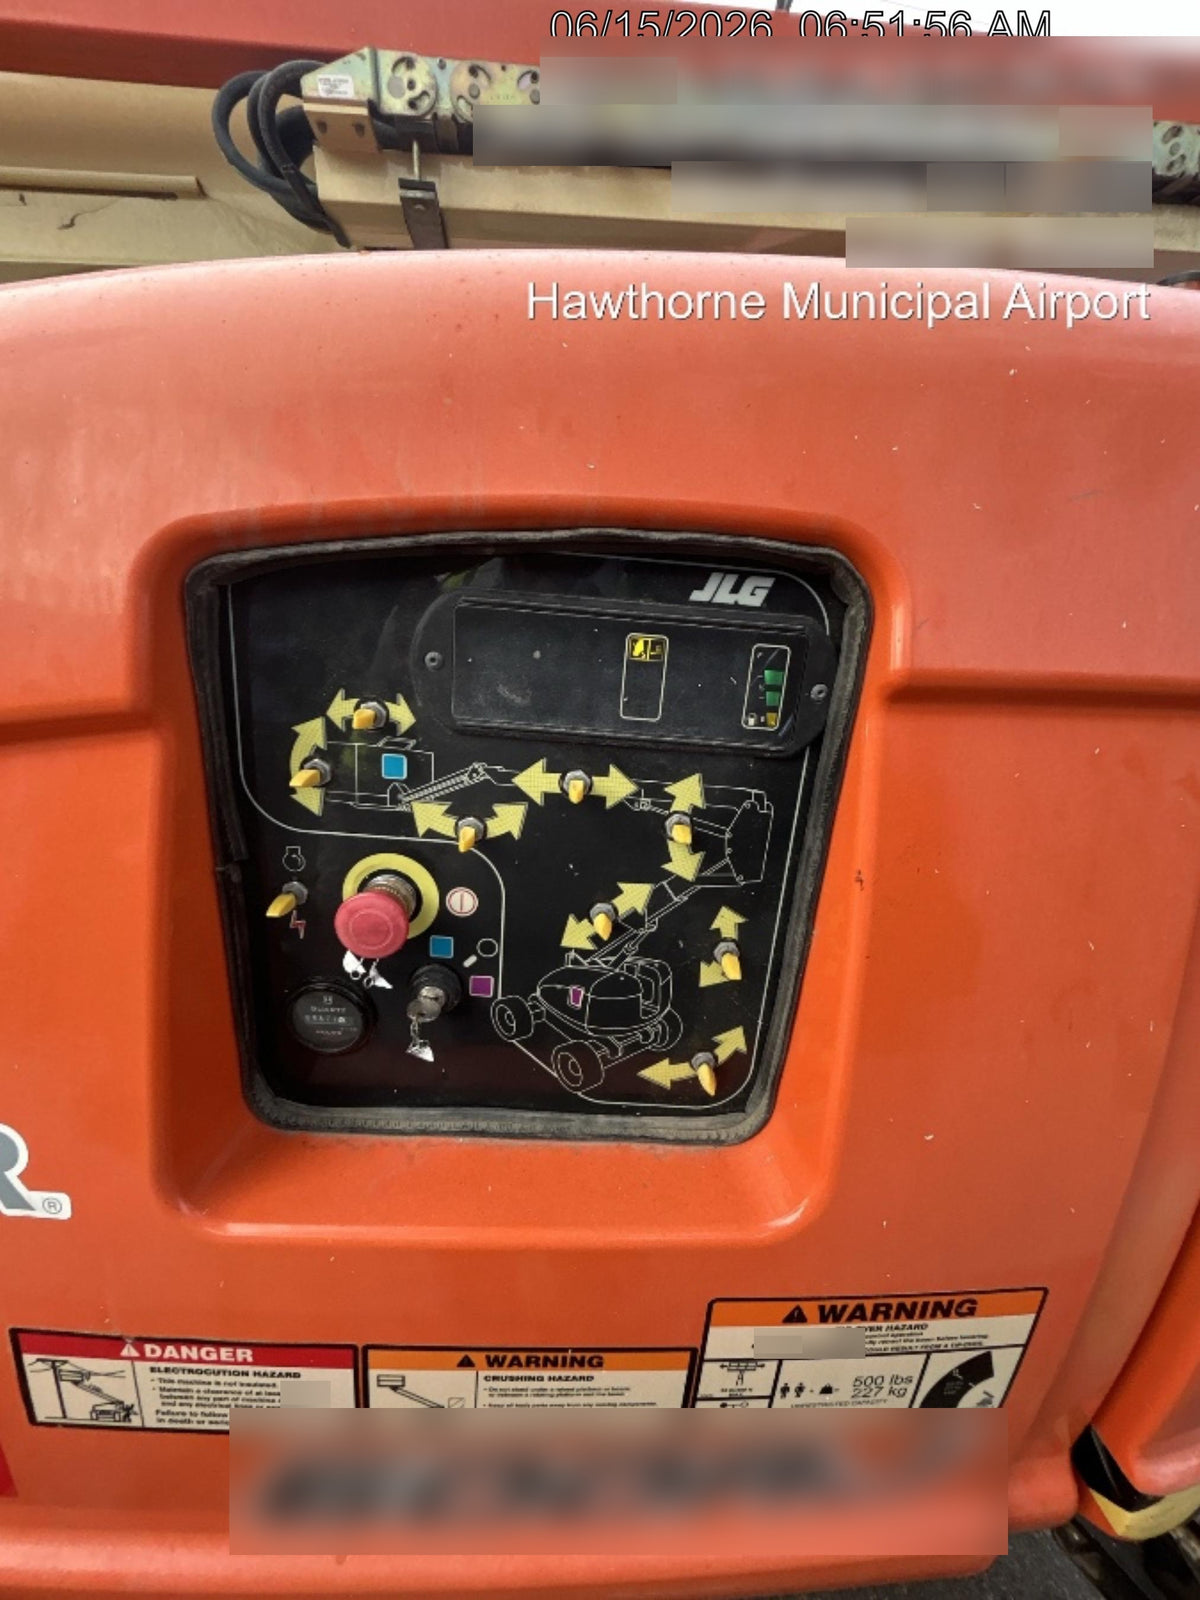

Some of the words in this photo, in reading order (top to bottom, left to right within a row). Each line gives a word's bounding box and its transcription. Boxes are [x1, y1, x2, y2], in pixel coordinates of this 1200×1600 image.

[689, 572, 776, 607] JLG
[818, 1299, 978, 1323] WARNING
[144, 1343, 254, 1363] DANGER
[485, 1354, 604, 1369] WARNING
[149, 1366, 250, 1378] ELECTROCUTION
[253, 1370, 302, 1379] HAZARD
[852, 1375, 885, 1388] 500
[889, 1374, 913, 1386] lbs
[851, 1386, 884, 1399] 227
[888, 1386, 908, 1398] kg
